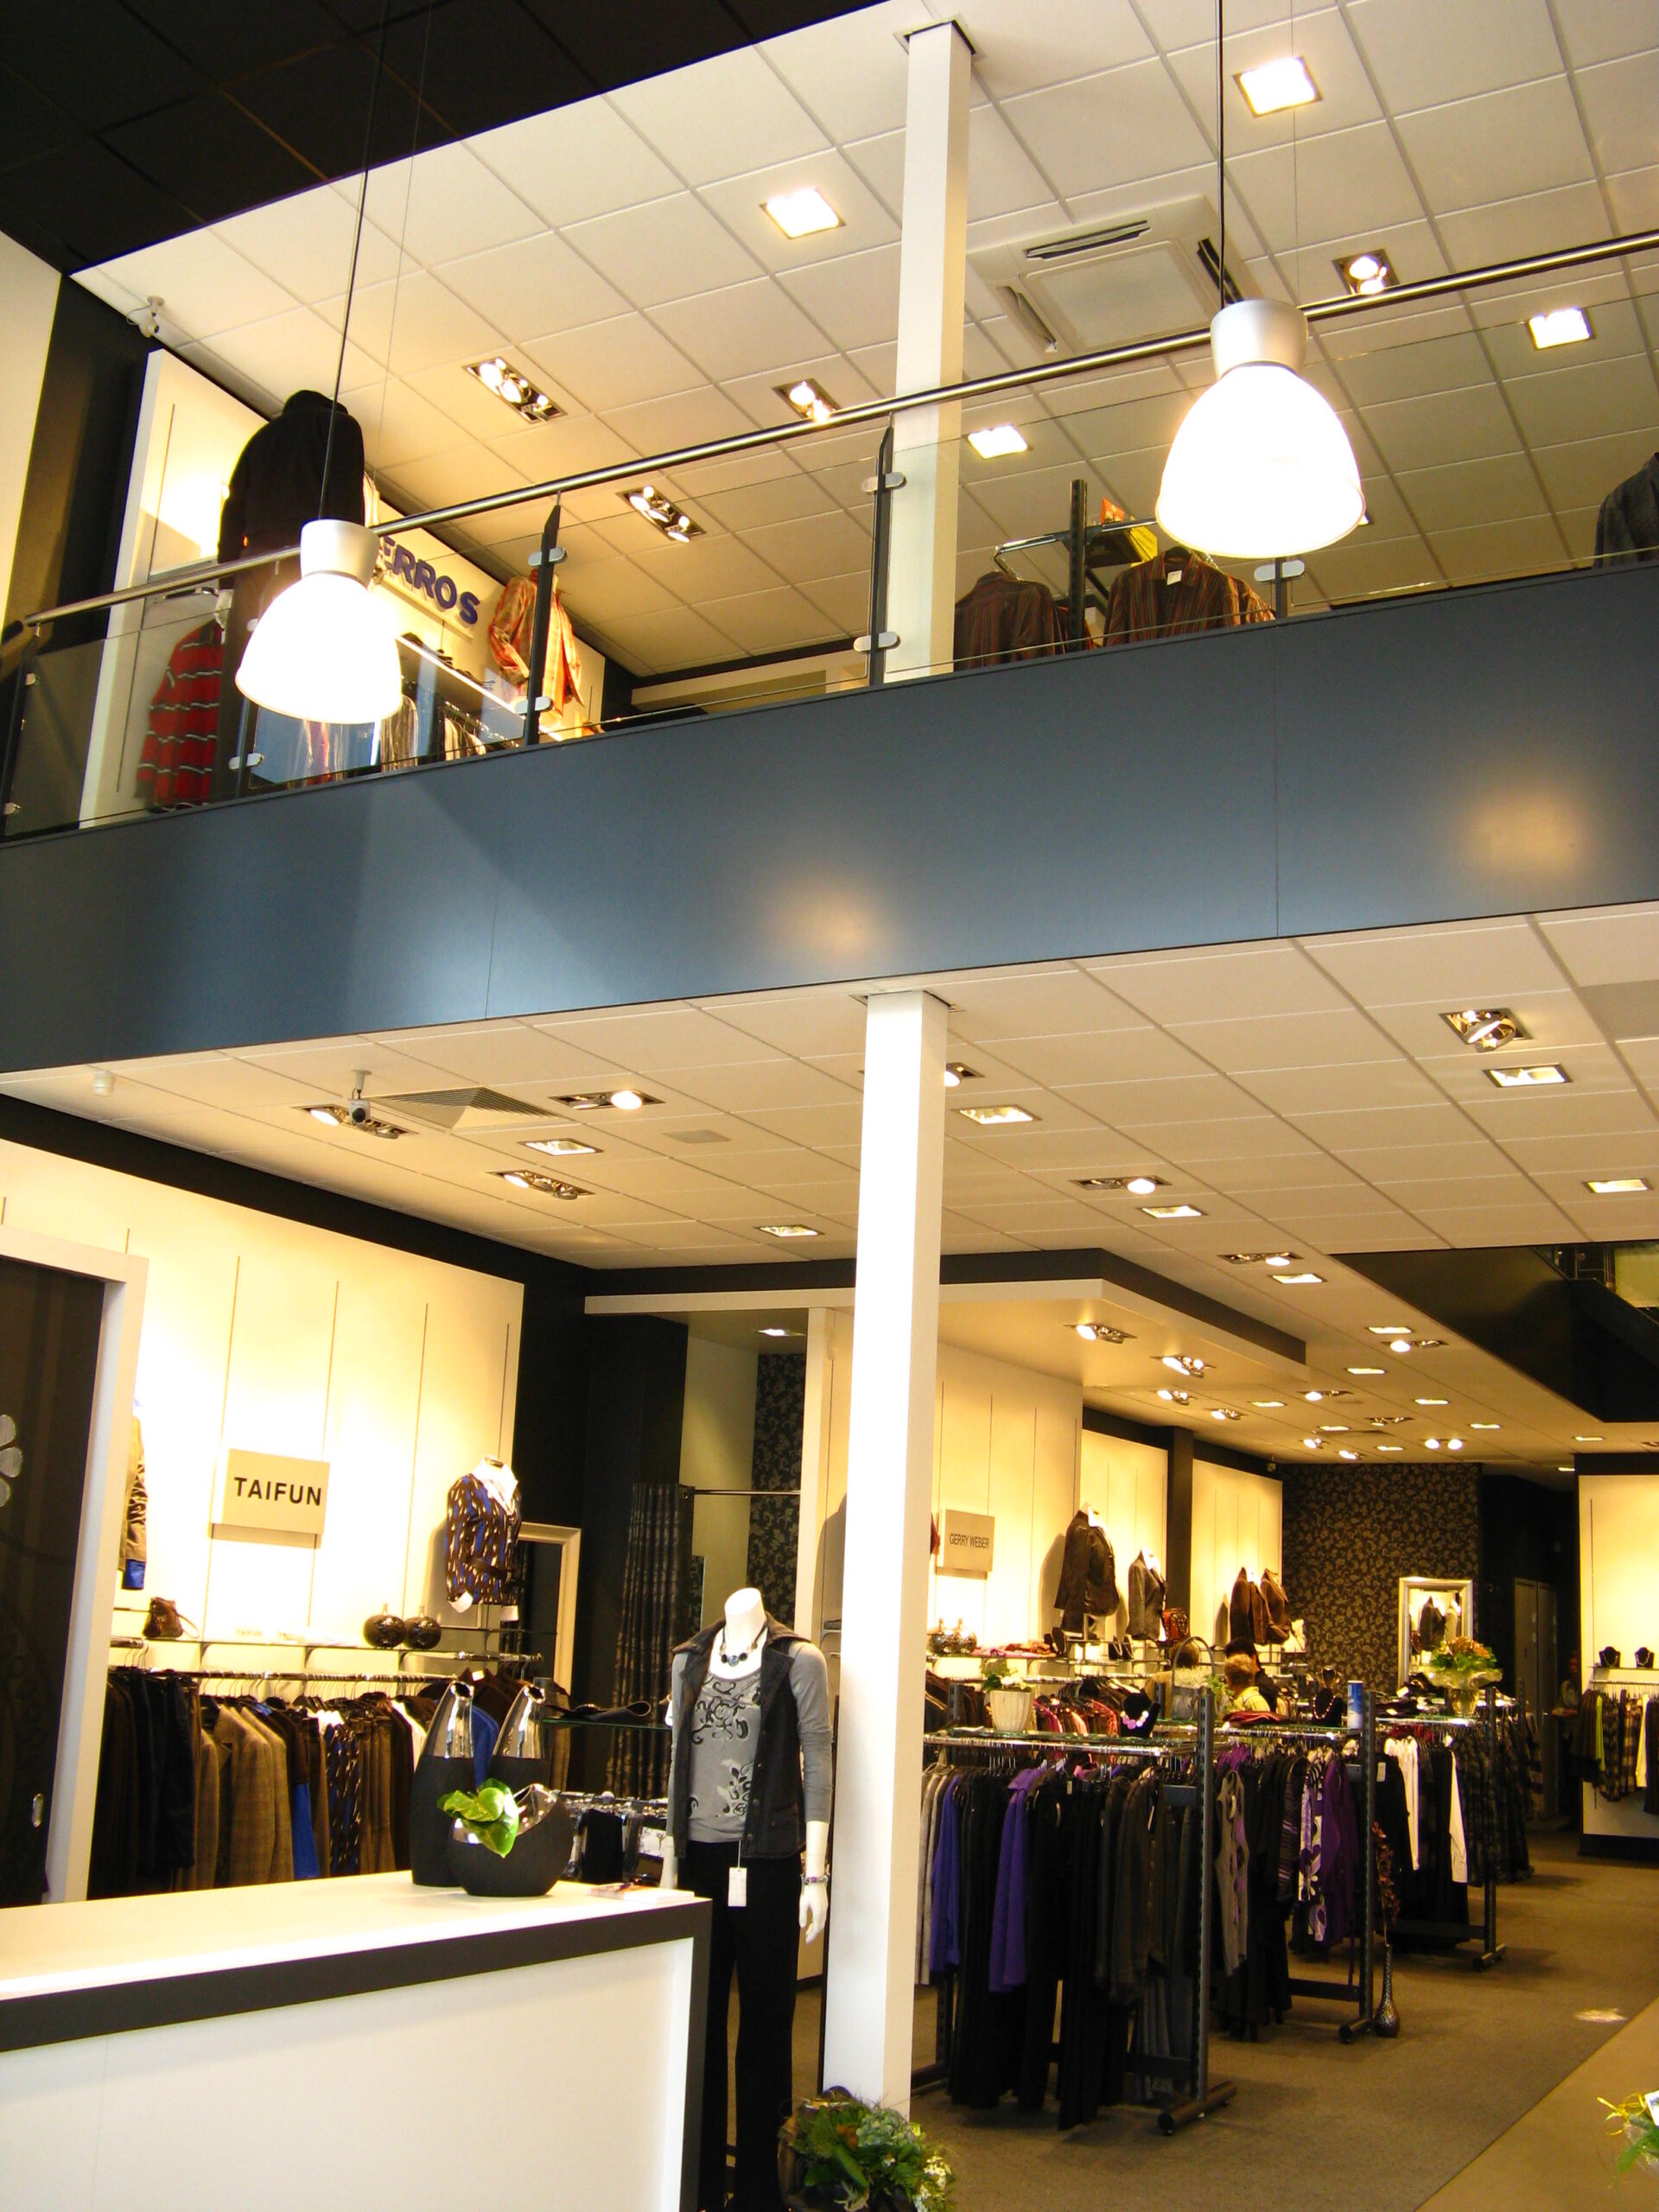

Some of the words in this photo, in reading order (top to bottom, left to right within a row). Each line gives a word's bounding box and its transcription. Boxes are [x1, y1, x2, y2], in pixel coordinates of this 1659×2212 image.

[384, 536, 480, 625] ERROS
[233, 1477, 321, 1506] TAIFUN
[949, 1533, 969, 1547] GERRY
[969, 1535, 989, 1549] WEBER
